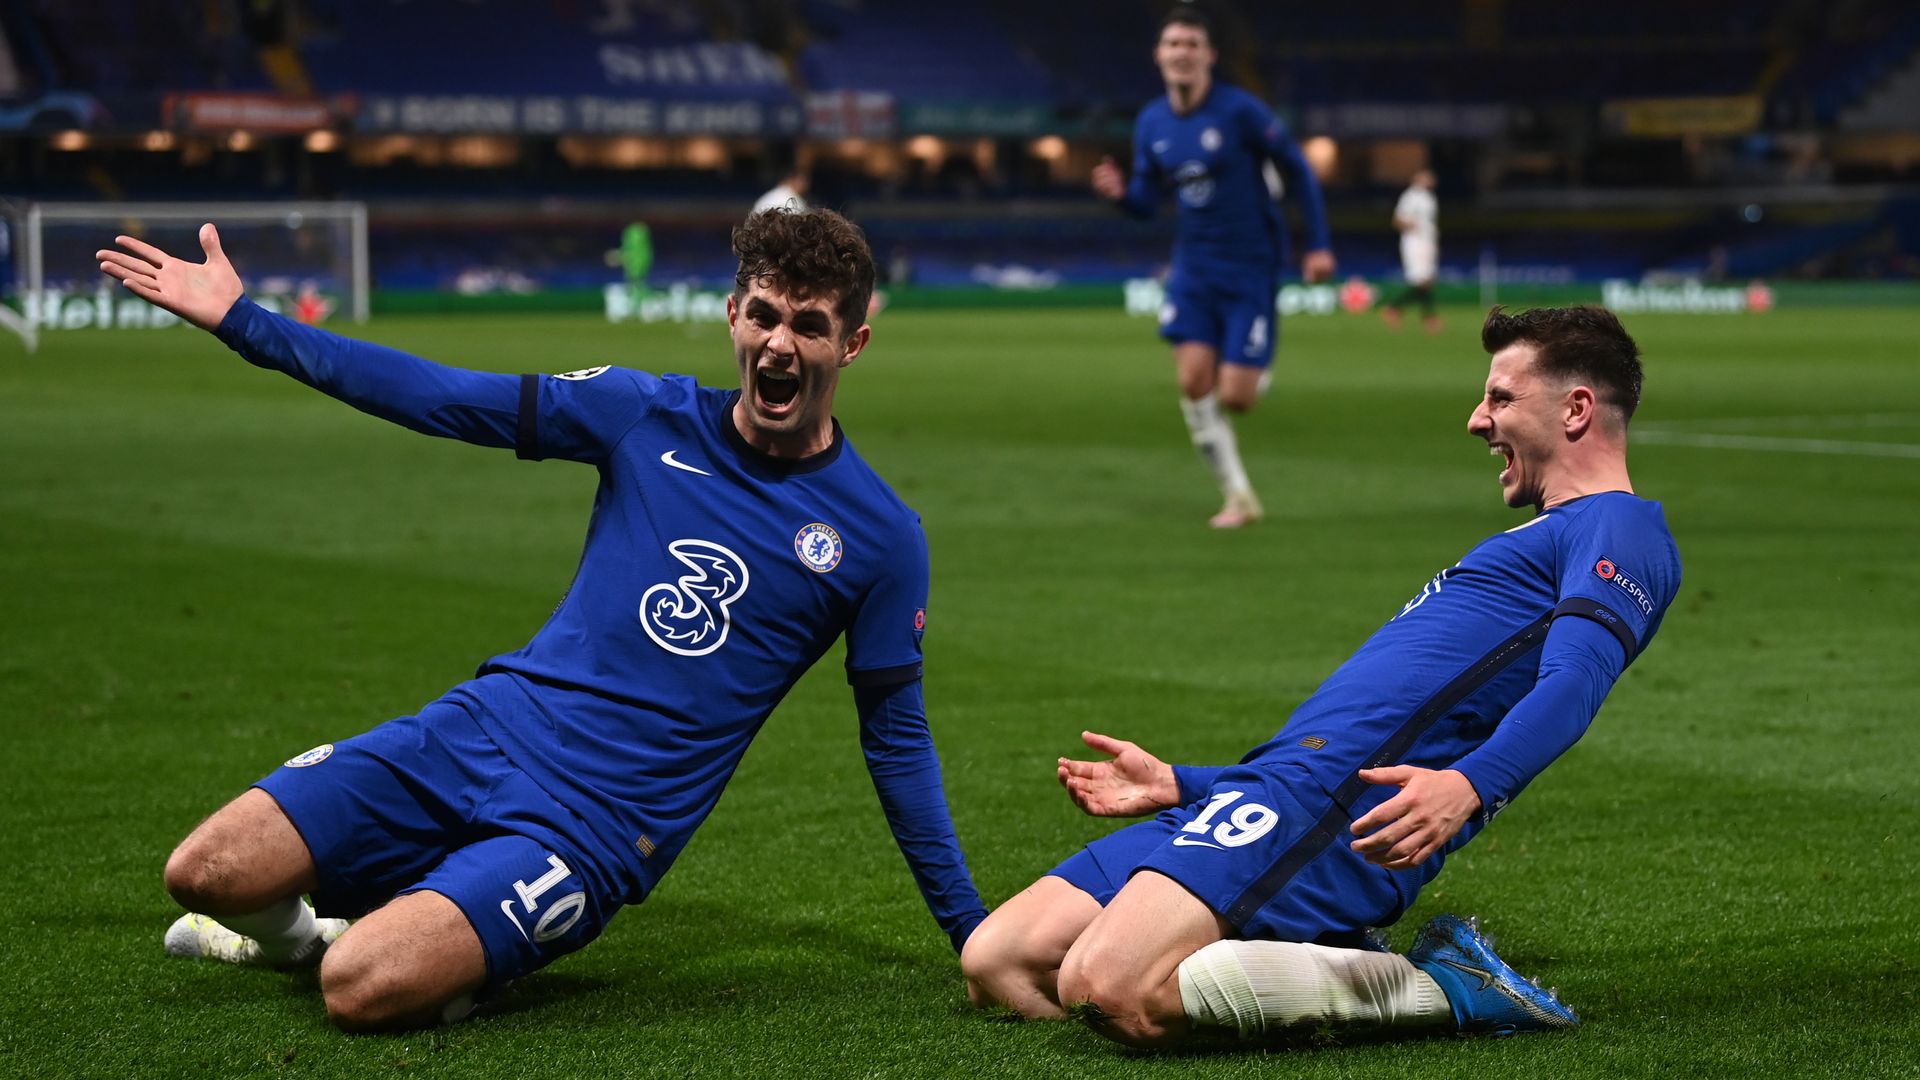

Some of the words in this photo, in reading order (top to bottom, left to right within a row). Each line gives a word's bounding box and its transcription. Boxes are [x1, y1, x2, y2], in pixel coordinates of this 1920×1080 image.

[401, 98, 515, 132] BORN
[524, 98, 566, 132] IS
[580, 98, 654, 132] THE
[664, 99, 763, 133] KING
[810, 524, 840, 545] CHELSEA
[639, 539, 749, 657] 3
[1613, 573, 1653, 616] RESPECT
[1181, 790, 1279, 848] 19
[512, 854, 586, 943] 10
